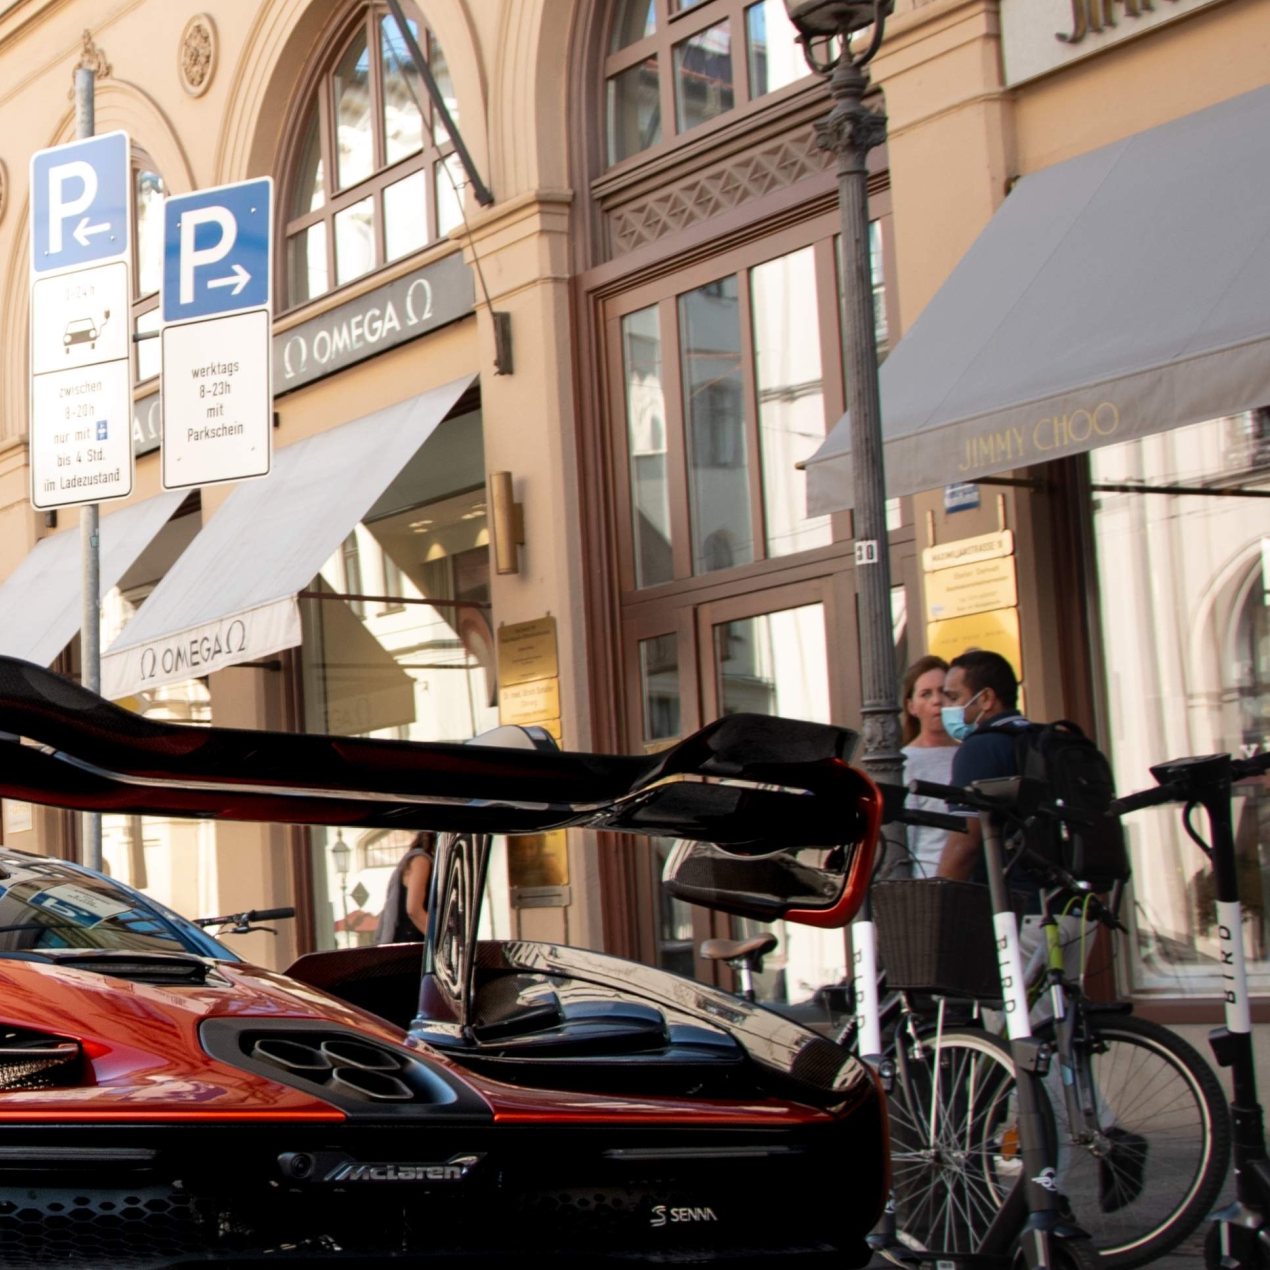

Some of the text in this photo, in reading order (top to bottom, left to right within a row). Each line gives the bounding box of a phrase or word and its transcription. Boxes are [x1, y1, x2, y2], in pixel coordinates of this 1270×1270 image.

[48, 161, 98, 254] P
[180, 205, 238, 305] P
[312, 301, 401, 364] OMEGA
[191, 361, 239, 379] werktags
[58, 380, 102, 398] zwischen
[199, 380, 231, 399] 8-23h
[206, 402, 224, 418] mit
[53, 428, 91, 445] nur mit
[187, 421, 244, 442] Parkschein
[958, 402, 1119, 471] JIMMY CHOO
[57, 447, 106, 467] bis 4 Std.
[43, 468, 120, 492] im Ladezustand
[161, 633, 223, 674] OMEGA
[344, 1163, 461, 1181] McLaren
[669, 1206, 718, 1223] SENNA
